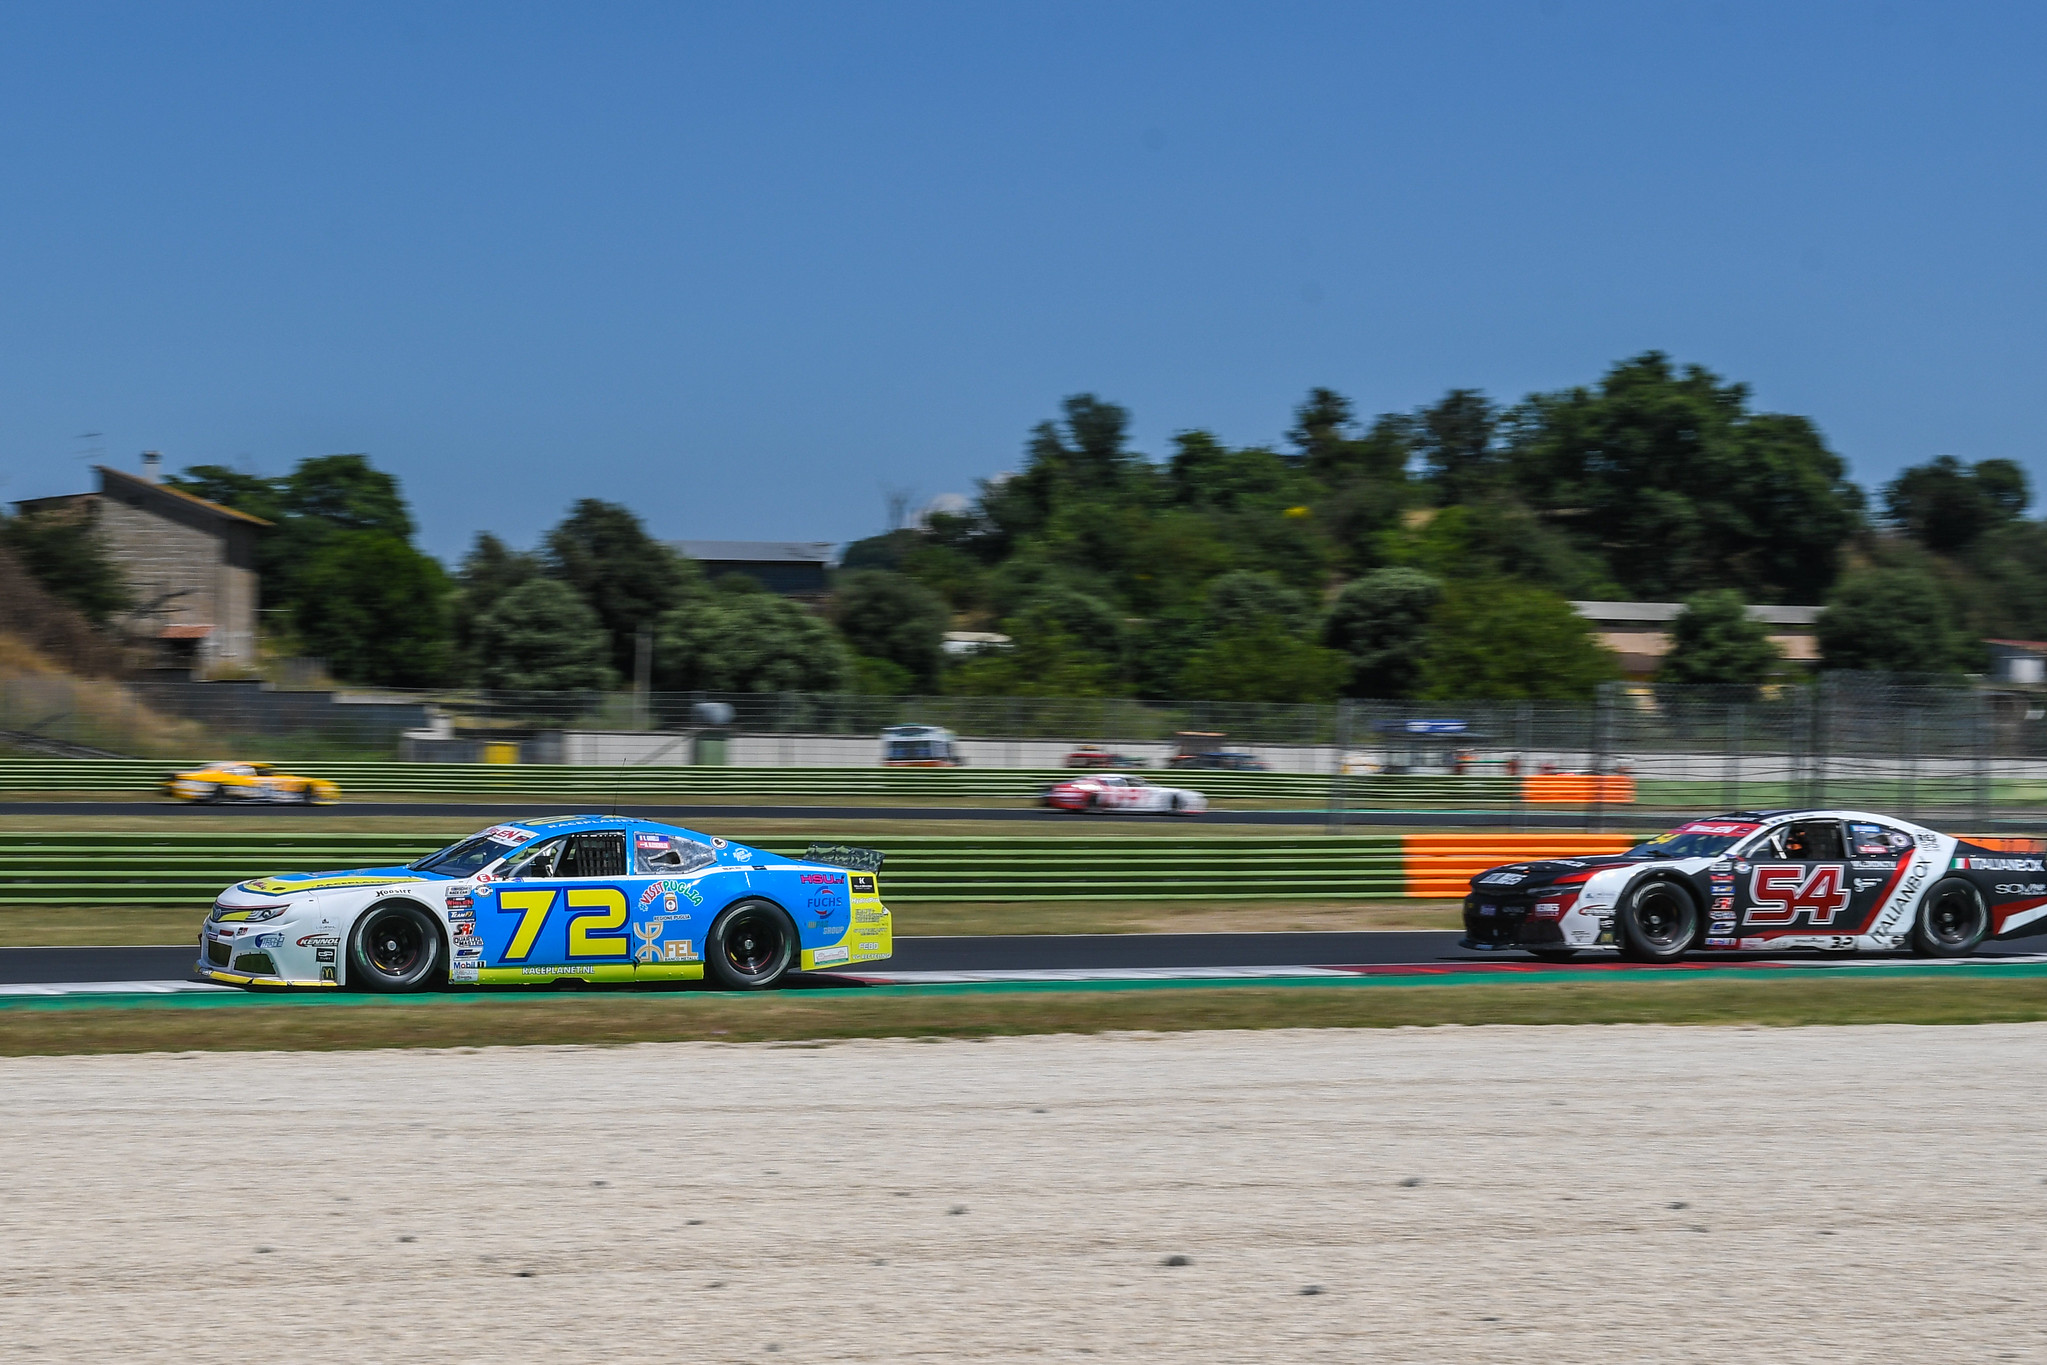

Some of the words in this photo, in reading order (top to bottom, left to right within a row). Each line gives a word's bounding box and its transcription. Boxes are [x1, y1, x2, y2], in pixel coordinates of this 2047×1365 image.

[1741, 864, 1851, 926] 54
[807, 897, 843, 908] FUCHS
[496, 885, 630, 963] 72
[299, 937, 340, 945] KENNOL
[664, 941, 698, 957] FEL
[454, 961, 476, 969] Mobil
[522, 965, 595, 975] RACEPLANET.NL
